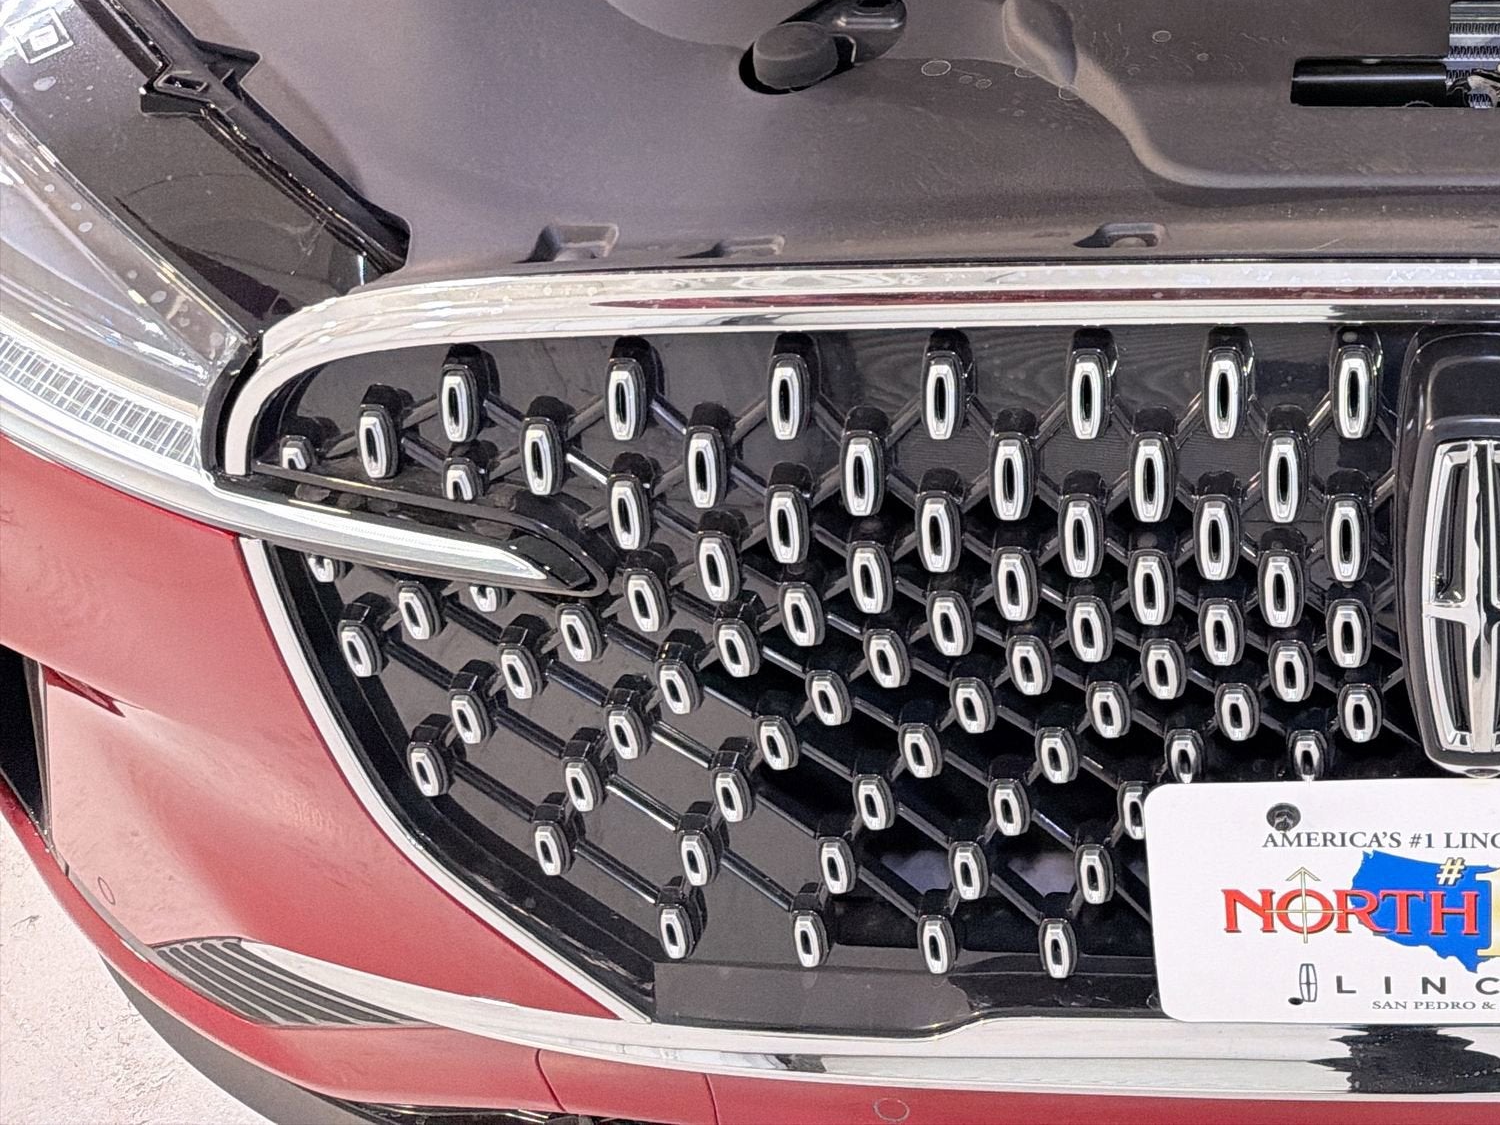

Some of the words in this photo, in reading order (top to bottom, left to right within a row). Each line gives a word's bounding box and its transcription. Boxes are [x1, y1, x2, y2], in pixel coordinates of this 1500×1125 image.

[1262, 831, 1402, 849] AMERICA'S
[1409, 832, 1434, 849] #1
[1222, 888, 1480, 935] NORTH
[1371, 1000, 1408, 1011] SAN
[1413, 1000, 1476, 1011] PEDRO
[1481, 1000, 1496, 1011] &
